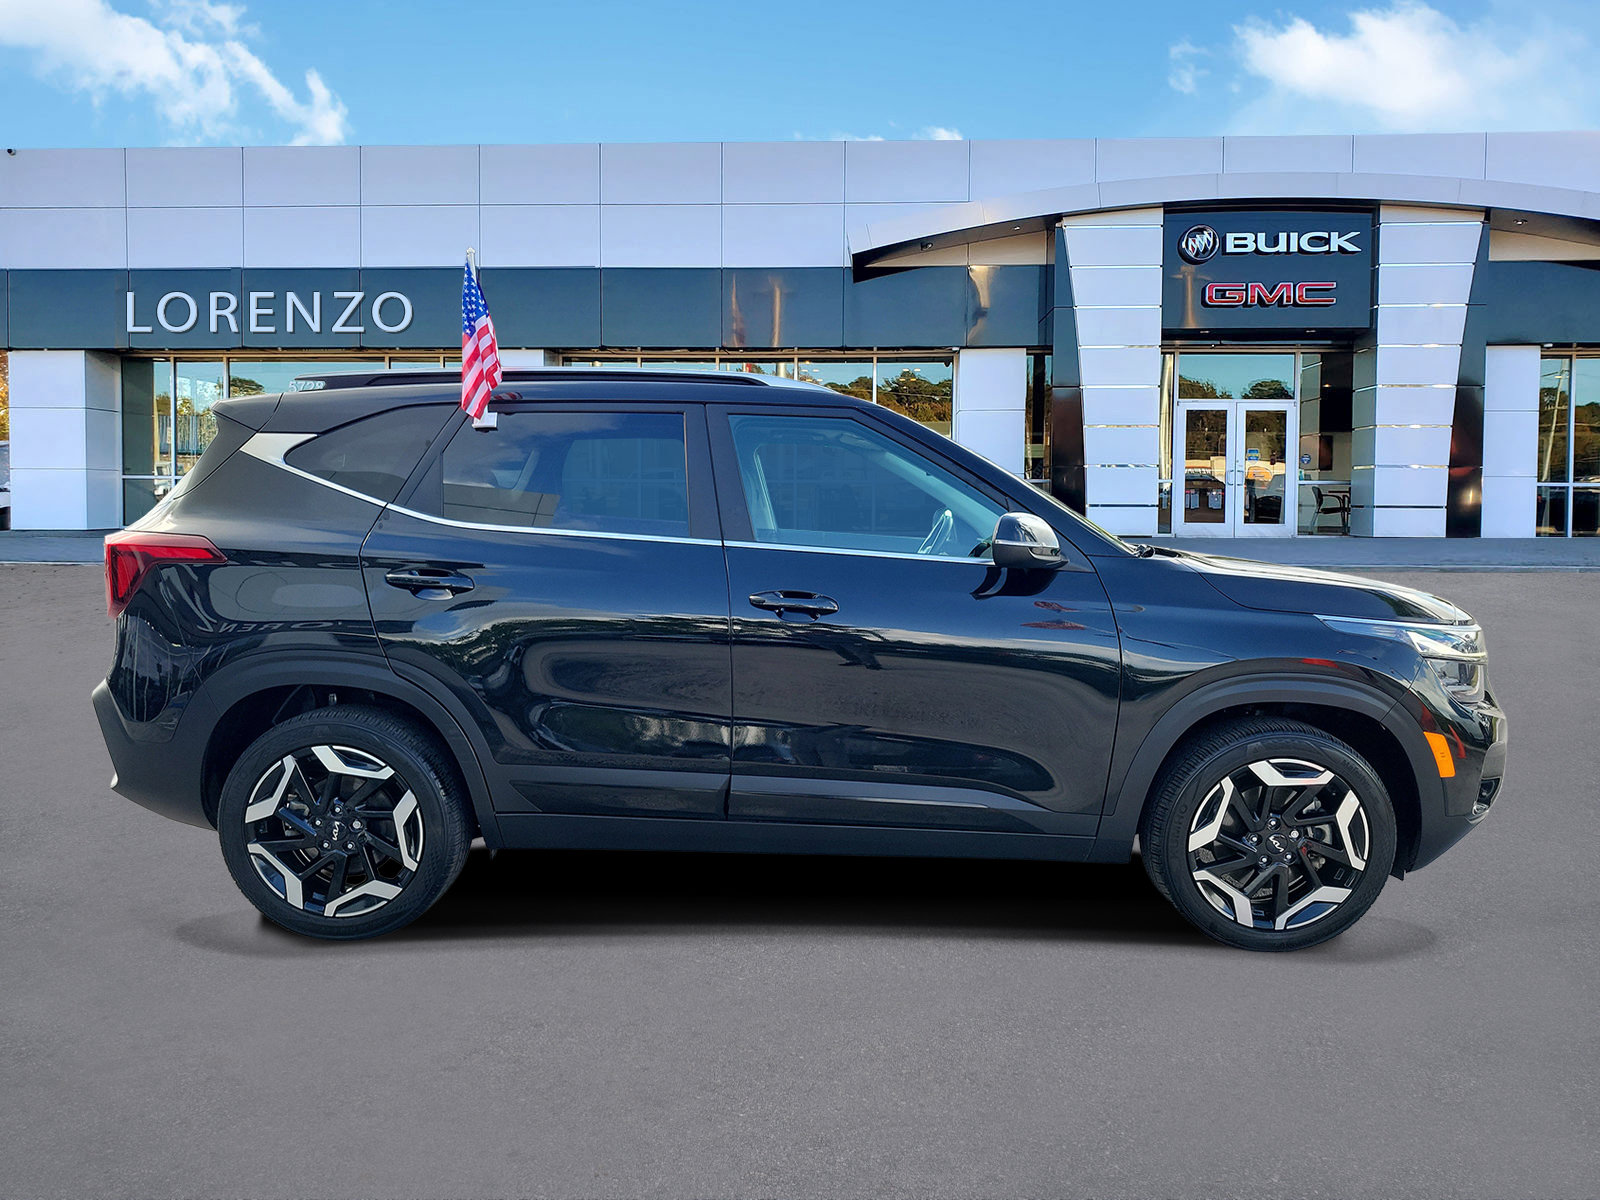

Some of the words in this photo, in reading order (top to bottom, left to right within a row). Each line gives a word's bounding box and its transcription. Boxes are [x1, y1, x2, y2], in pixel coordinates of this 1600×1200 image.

[1225, 231, 1362, 253] BUICK
[1206, 282, 1337, 305] GMC
[126, 291, 413, 333] LORENZO
